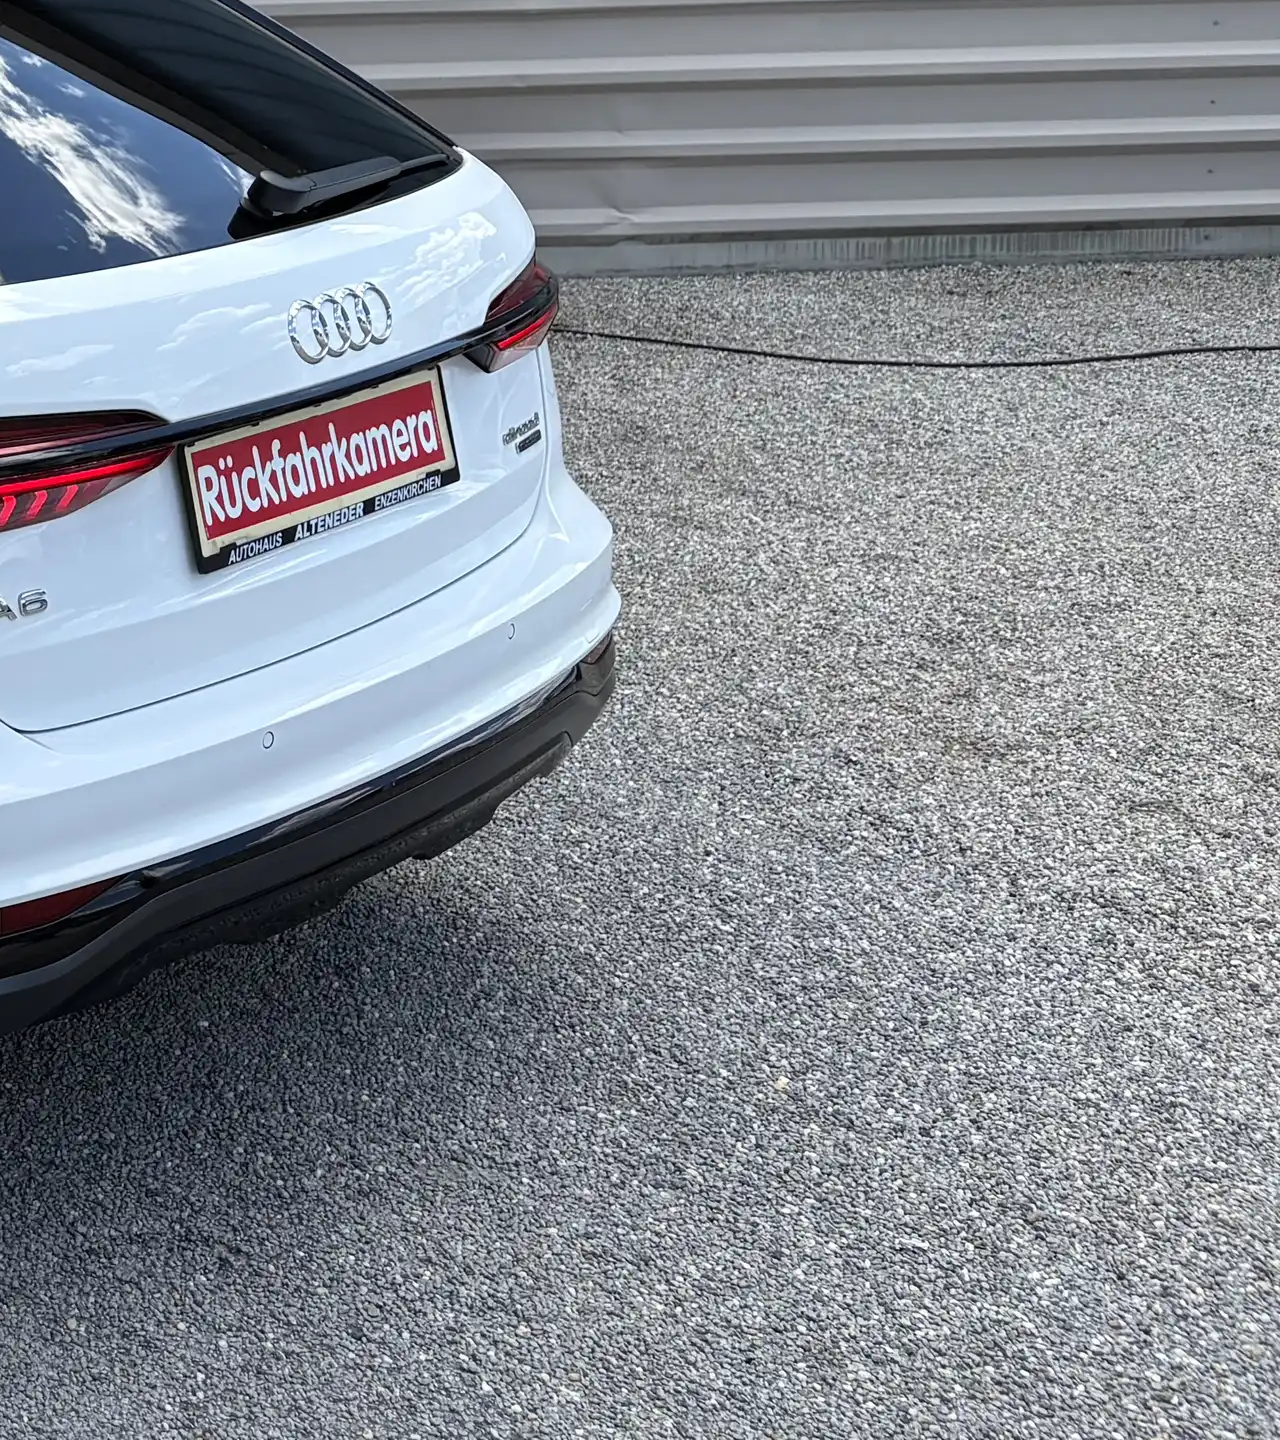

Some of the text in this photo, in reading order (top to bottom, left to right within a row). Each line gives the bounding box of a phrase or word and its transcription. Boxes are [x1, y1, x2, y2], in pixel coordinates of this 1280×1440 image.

[197, 408, 438, 527] Rückfahrkamera
[228, 474, 441, 566] AUTOHAUS ALTENEDER ENZENKIRCHEN
